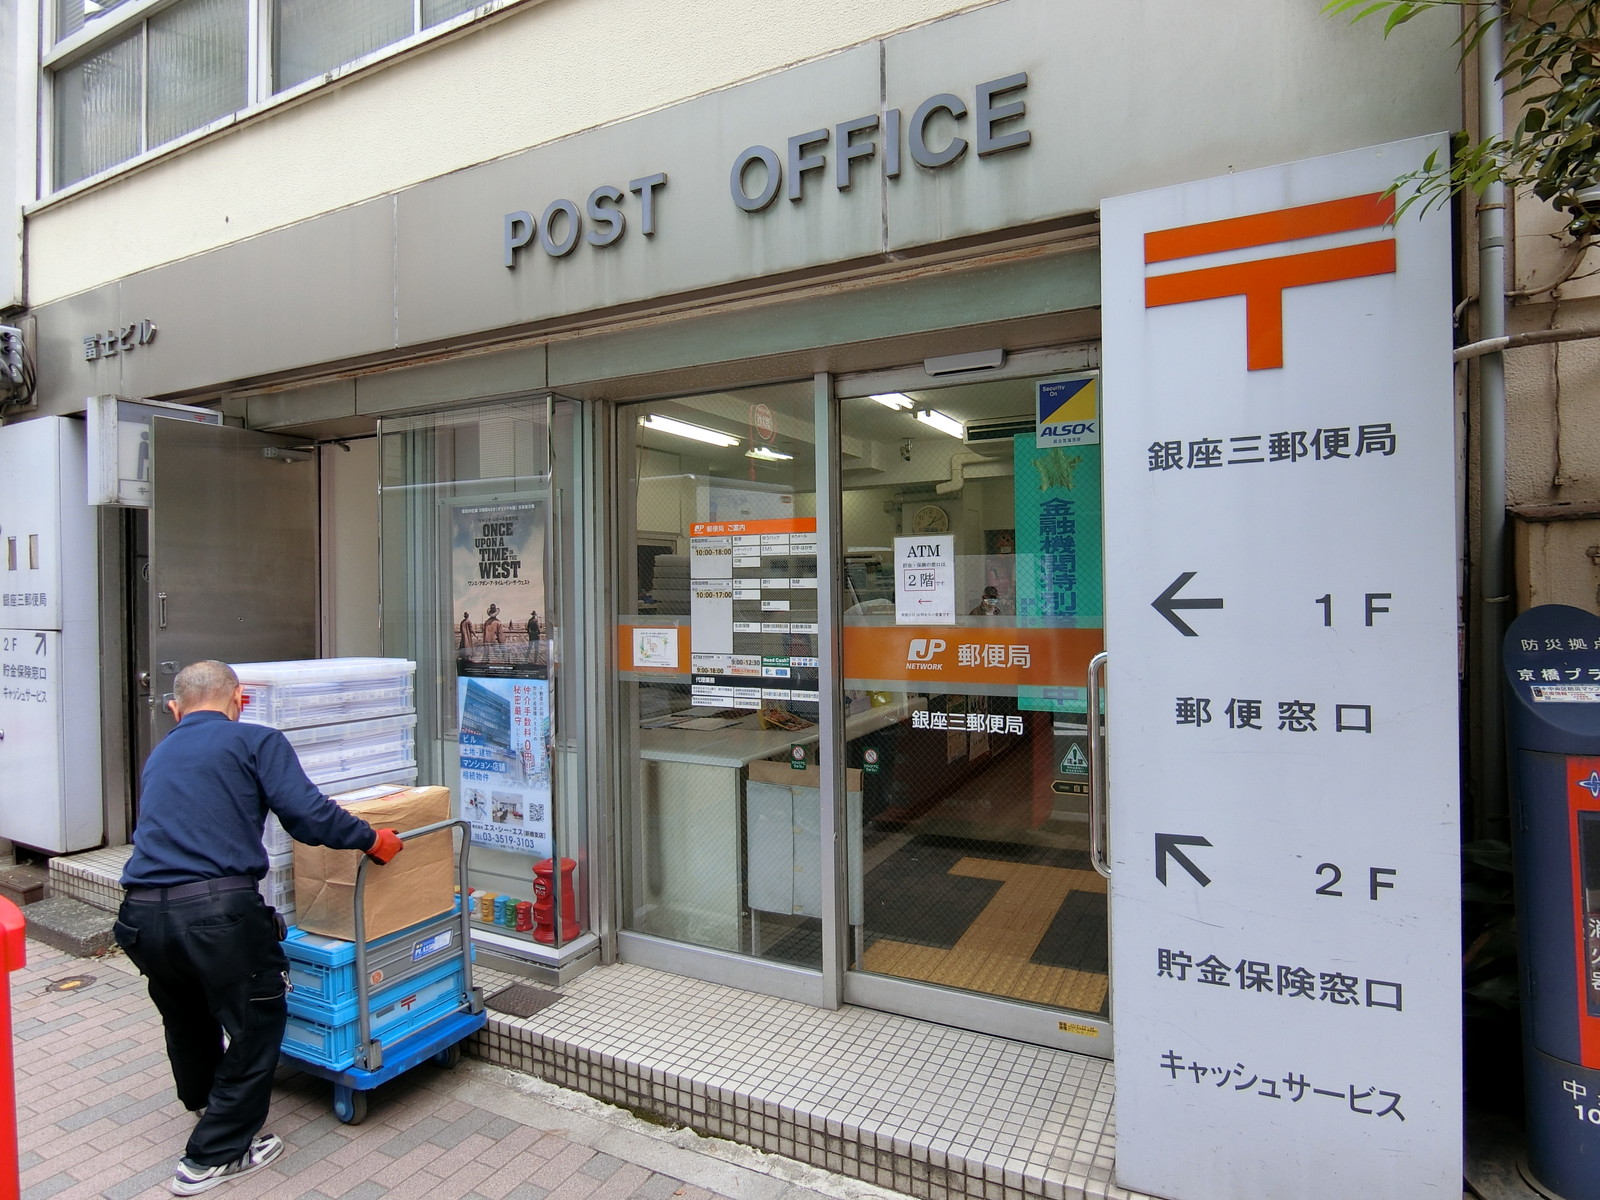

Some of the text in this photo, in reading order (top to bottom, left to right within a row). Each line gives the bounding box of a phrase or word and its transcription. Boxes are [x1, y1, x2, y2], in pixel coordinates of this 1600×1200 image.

[504, 72, 1031, 269] POST OFFICE
[1040, 422, 1095, 437] ALSOK
[1147, 422, 1397, 472] 銀座三郵便局
[482, 522, 514, 537] ONCE
[706, 525, 725, 533] 郵便局
[727, 524, 746, 532] ご案内
[475, 537, 505, 548] UPON A
[479, 548, 509, 561] TIME
[907, 544, 941, 558] ATM
[479, 561, 521, 579] WEST
[2, 592, 47, 607] 銀座三郵便局
[908, 639, 1031, 669] JP 郵便局
[3, 663, 47, 680] 貯金保険窓口
[1517, 667, 1600, 681] 京橋プラ
[3, 685, 48, 703] キャッシュサービス
[912, 710, 1024, 735] 銀座三郵便局
[1175, 696, 1372, 733] 郵便窓口
[463, 735, 477, 743] ビル
[463, 771, 489, 782] 相続物件
[483, 832, 535, 848] 03-3519-3103
[1157, 947, 1403, 1012] 貯金保険窓口
[1160, 1048, 1406, 1122] キャッシュサービス
